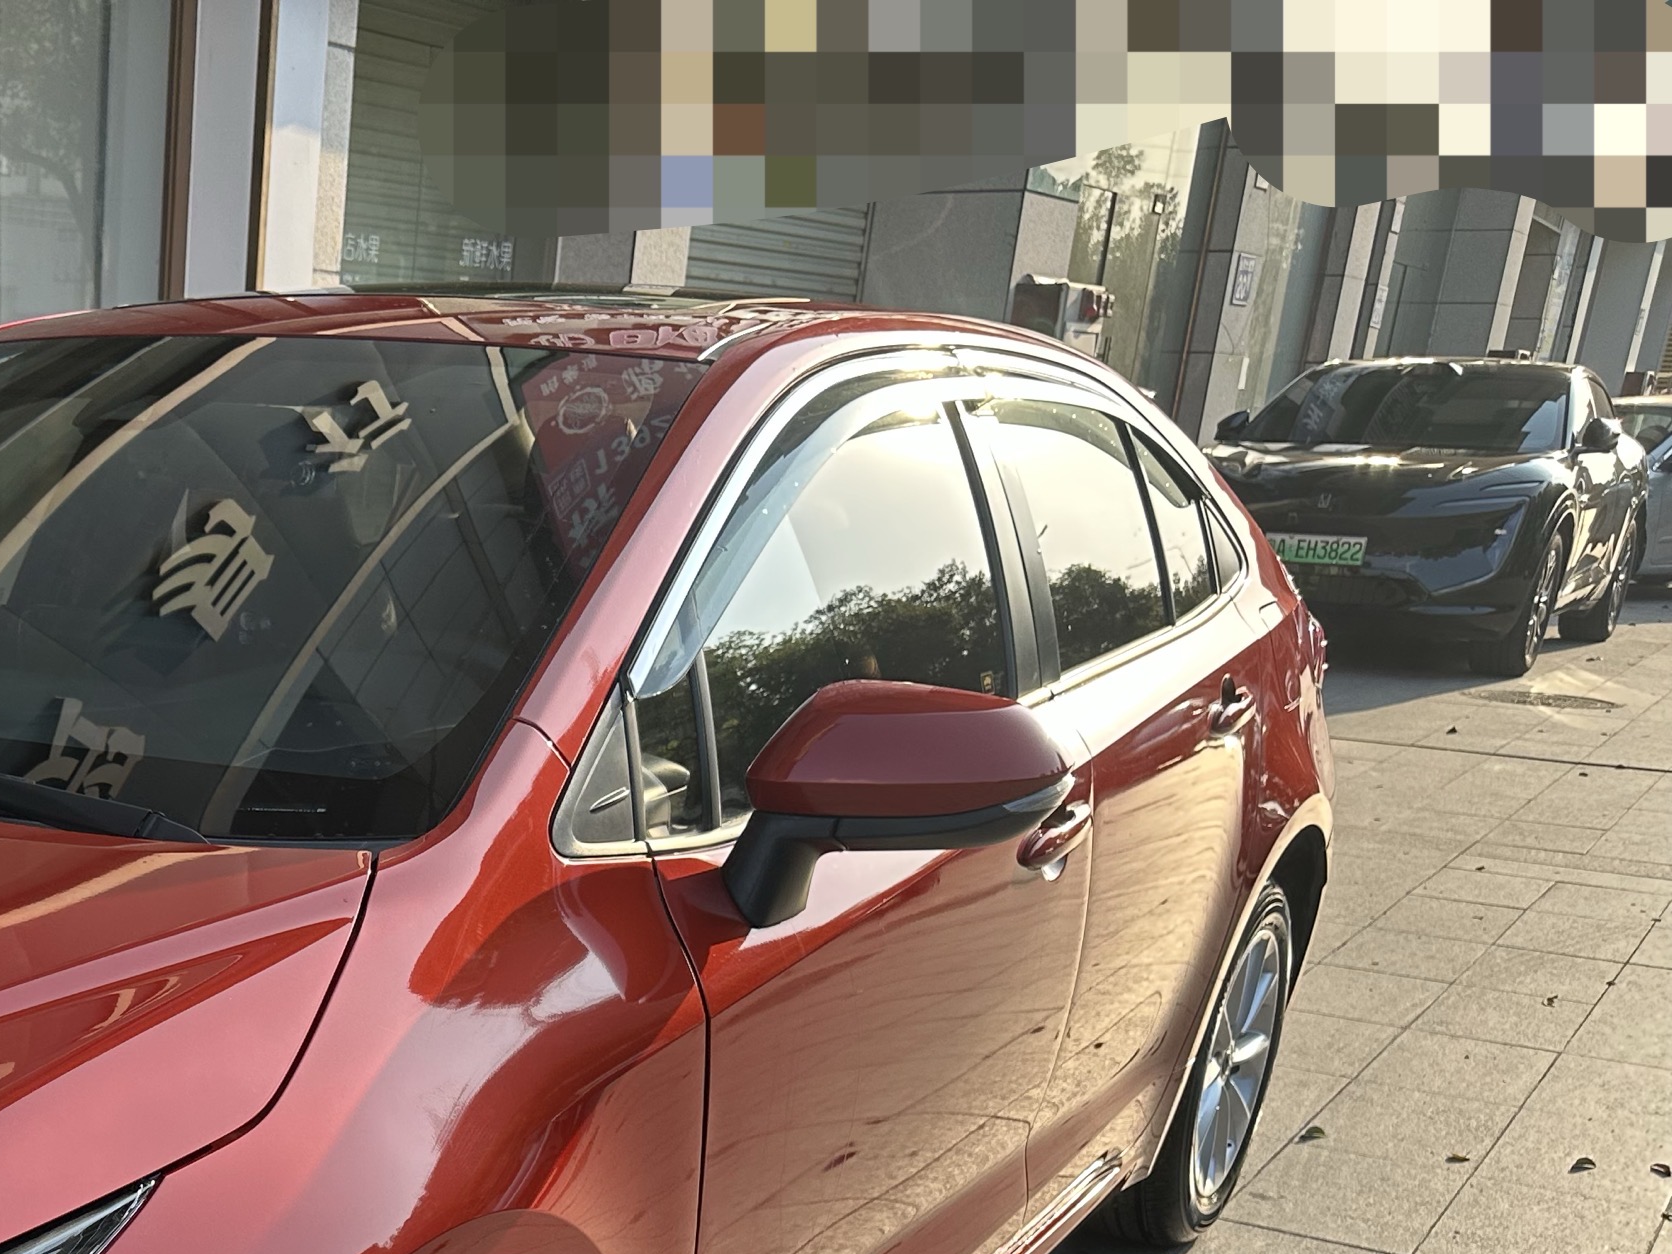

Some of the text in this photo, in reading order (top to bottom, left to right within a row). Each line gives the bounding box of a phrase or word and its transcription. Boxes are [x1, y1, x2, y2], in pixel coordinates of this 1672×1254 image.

[459, 238, 514, 271] 新鲜水果
[1294, 539, 1364, 562] EH3822
